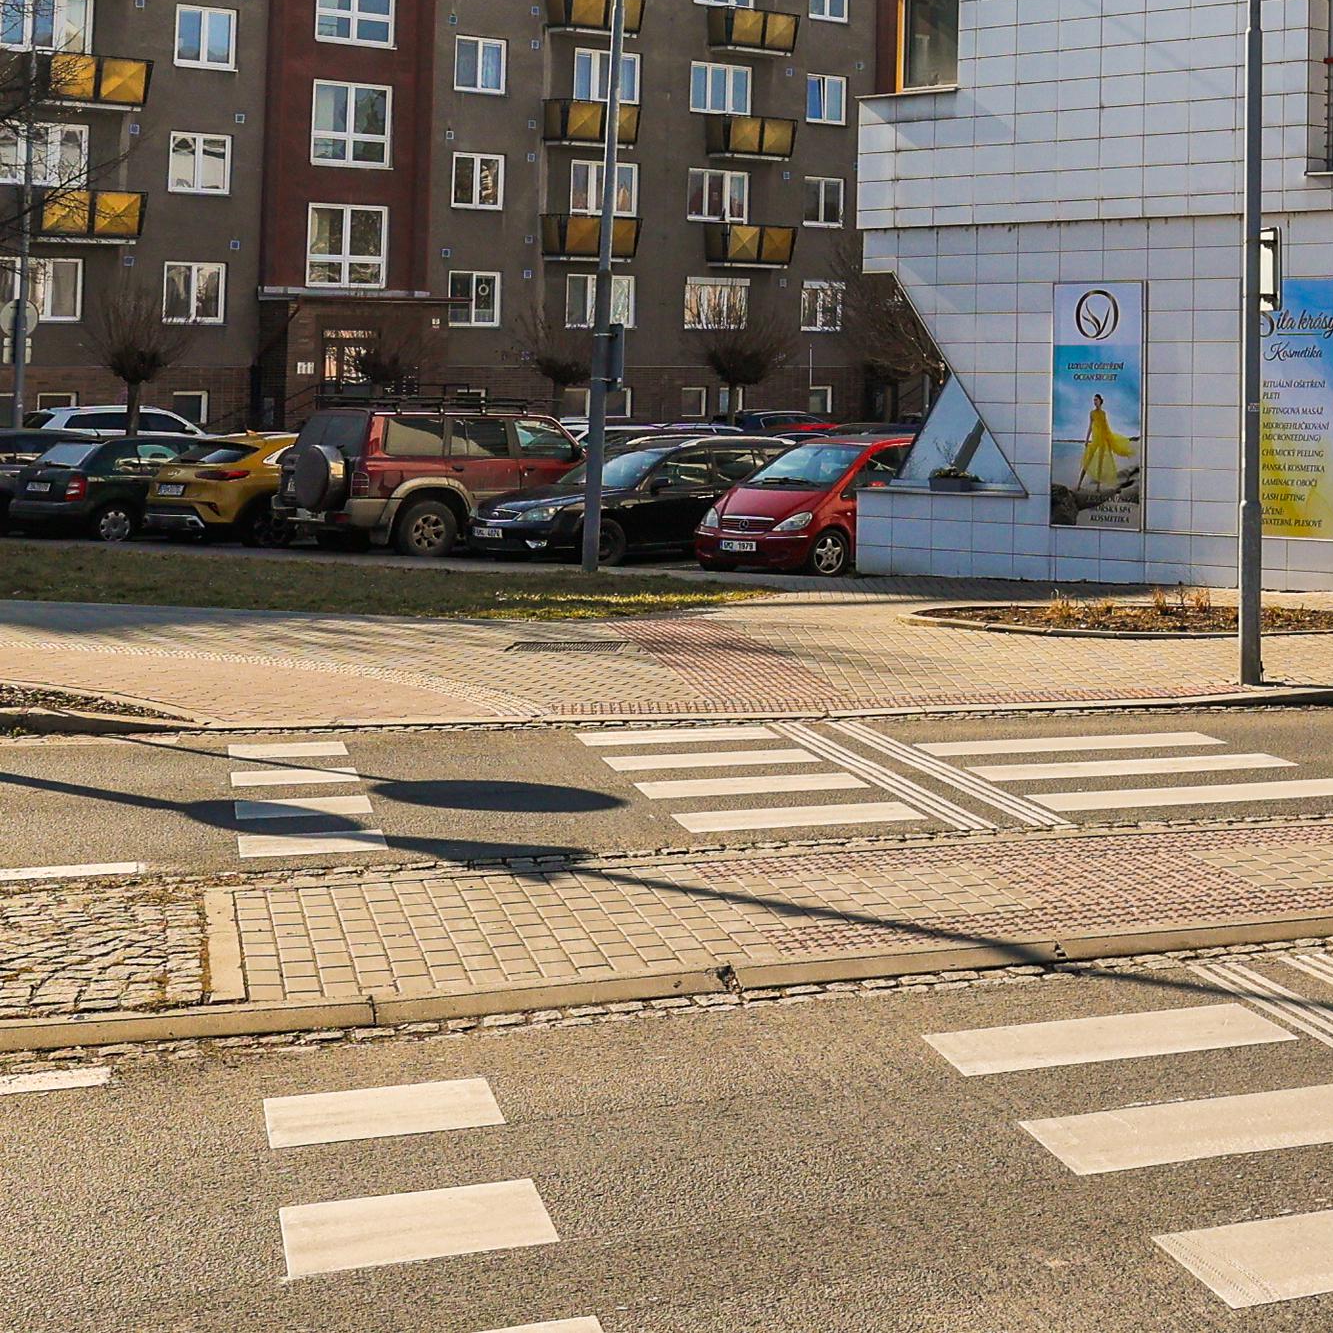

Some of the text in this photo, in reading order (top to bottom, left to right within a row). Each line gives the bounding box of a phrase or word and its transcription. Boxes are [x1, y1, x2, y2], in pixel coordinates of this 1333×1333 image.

[1264, 341, 1323, 362] Kosmetika
[1294, 379, 1326, 388] OŠETŘENÍ
[1296, 449, 1324, 458] PEELING
[1287, 464, 1326, 473] KOSMETIKA
[1262, 477, 1296, 486] LAMINACE
[1262, 492, 1306, 502] LASH LIFTING
[1090, 514, 1131, 524] KOSMETIKA
